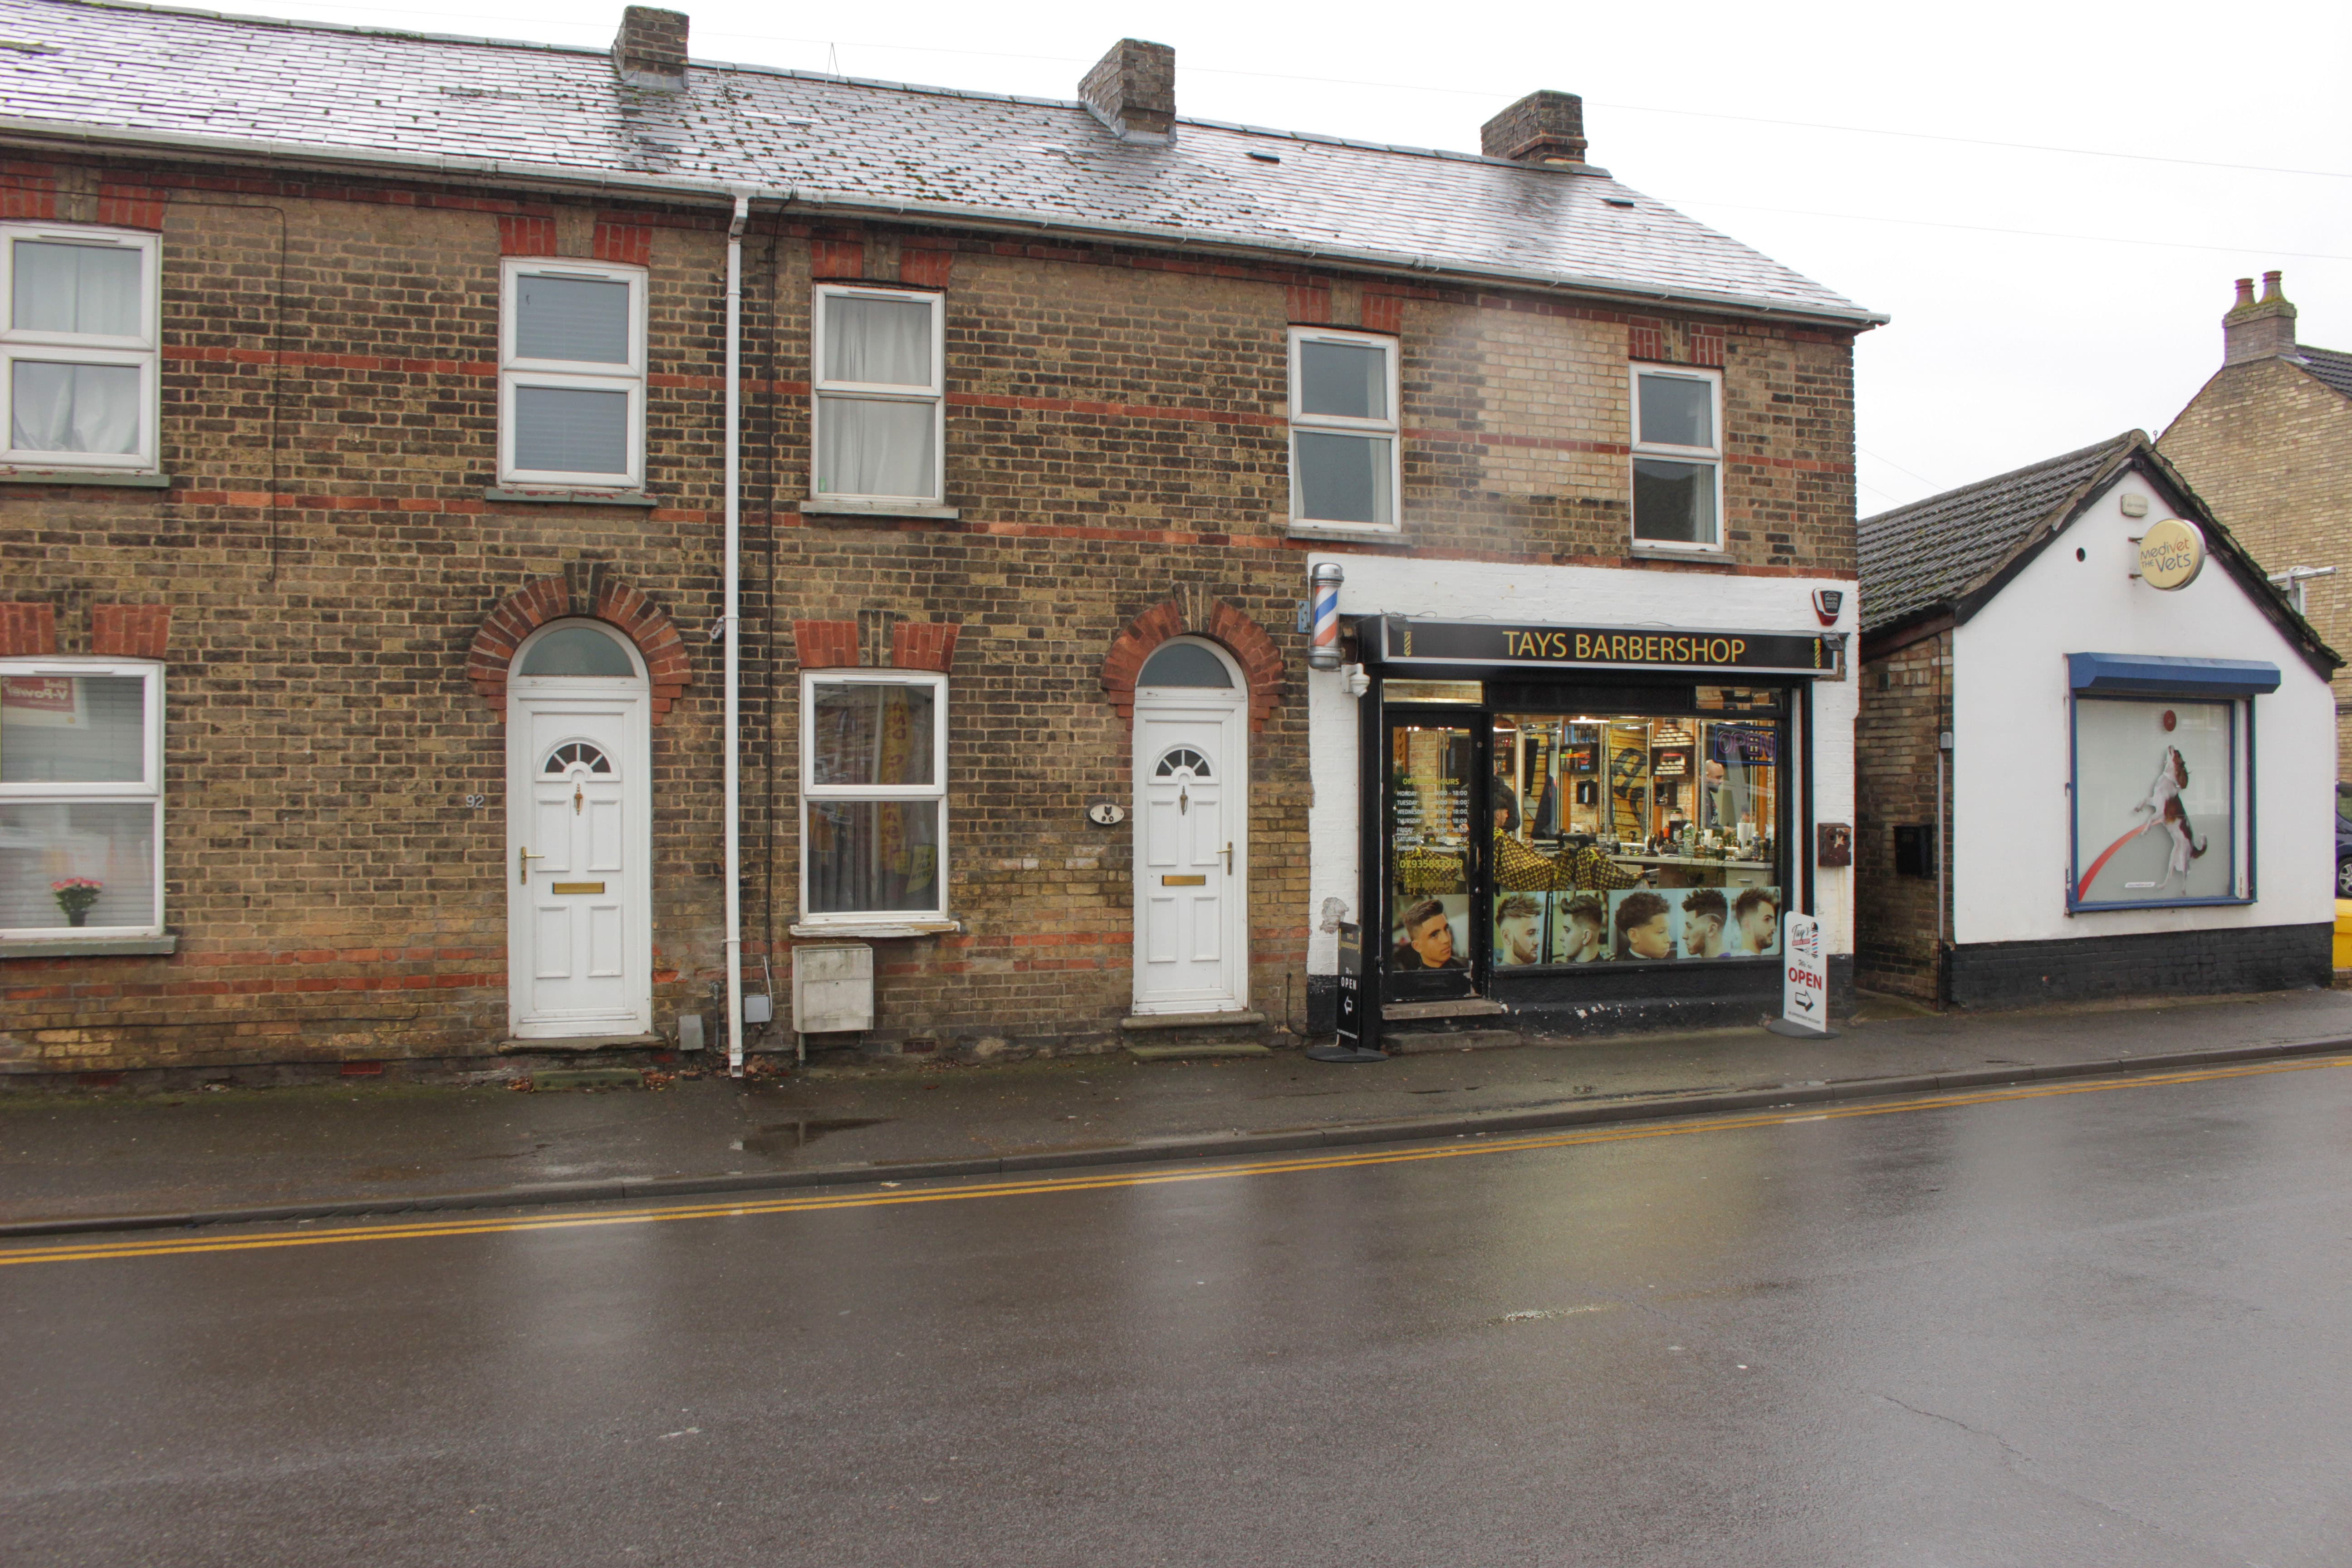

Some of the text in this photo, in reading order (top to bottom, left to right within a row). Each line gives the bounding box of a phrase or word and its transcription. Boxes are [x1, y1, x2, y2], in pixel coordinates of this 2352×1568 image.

[2141, 537, 2190, 560] Medivet
[2141, 553, 2190, 572] THE Vets
[1502, 631, 1745, 662] TAYS BARBERSHOP
[1719, 732, 1774, 757] OPEN
[466, 794, 484, 808] 92
[1792, 924, 1809, 941] Tay's
[1341, 976, 1357, 990] OPEN
[1788, 967, 1822, 990] OPEN
